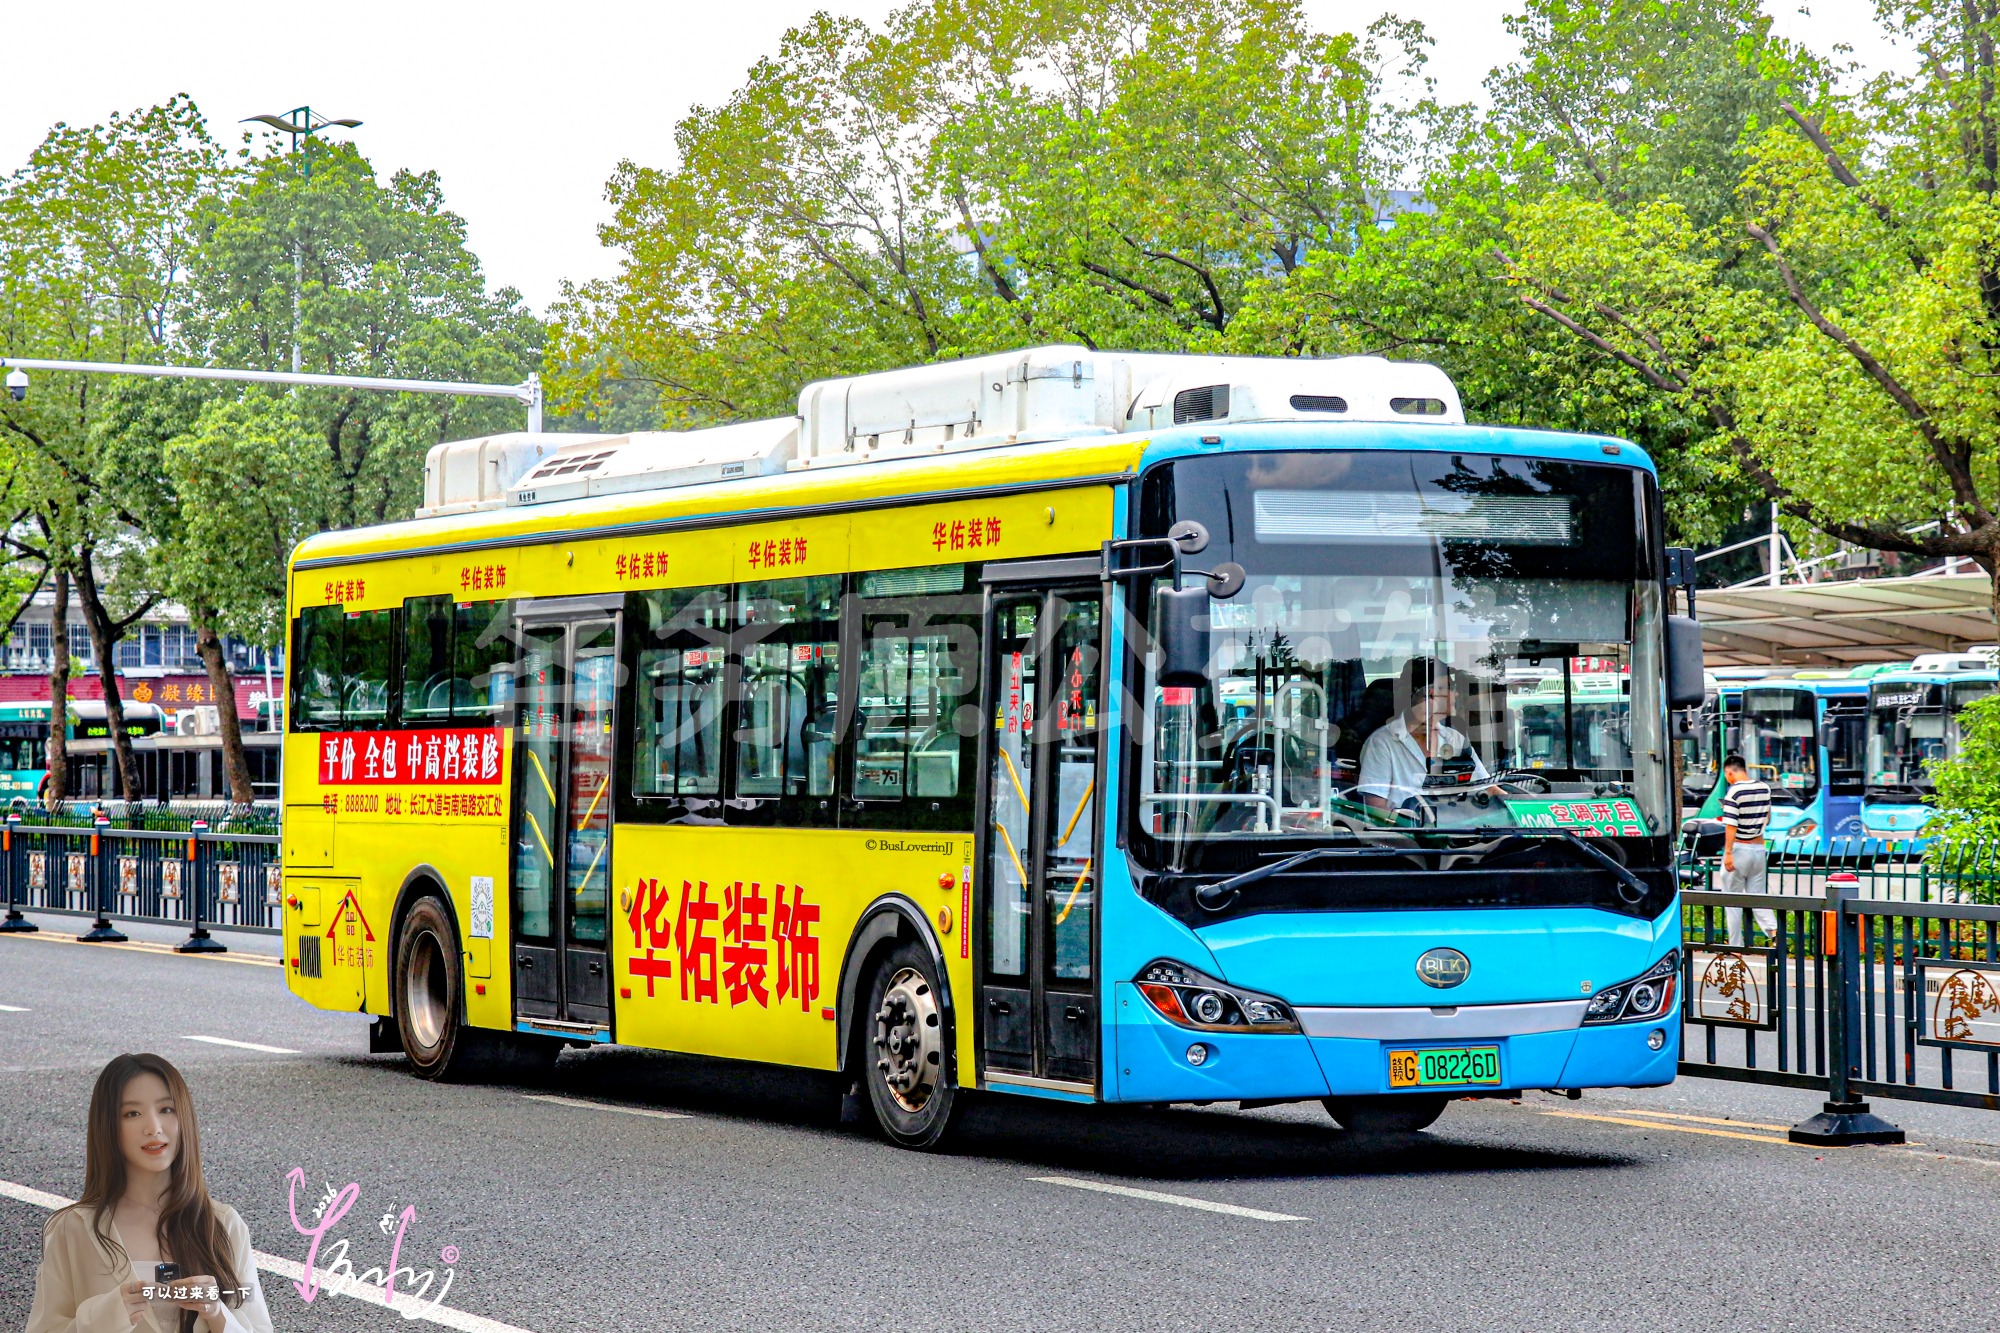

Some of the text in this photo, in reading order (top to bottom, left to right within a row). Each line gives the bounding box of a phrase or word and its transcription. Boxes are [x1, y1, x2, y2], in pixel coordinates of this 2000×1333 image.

[932, 516, 1001, 553] 华佑装饰
[616, 551, 669, 580] 华佑装饰
[749, 537, 807, 569] 华佑装饰
[325, 578, 366, 604] 华佑装饰
[461, 564, 506, 592] 华佑装饰
[323, 733, 499, 781] 平价 全包 中高档装修
[1548, 802, 1638, 823] 空调开启
[337, 945, 374, 969] 华佑装饰
[628, 877, 820, 1013] 华佑装饰
